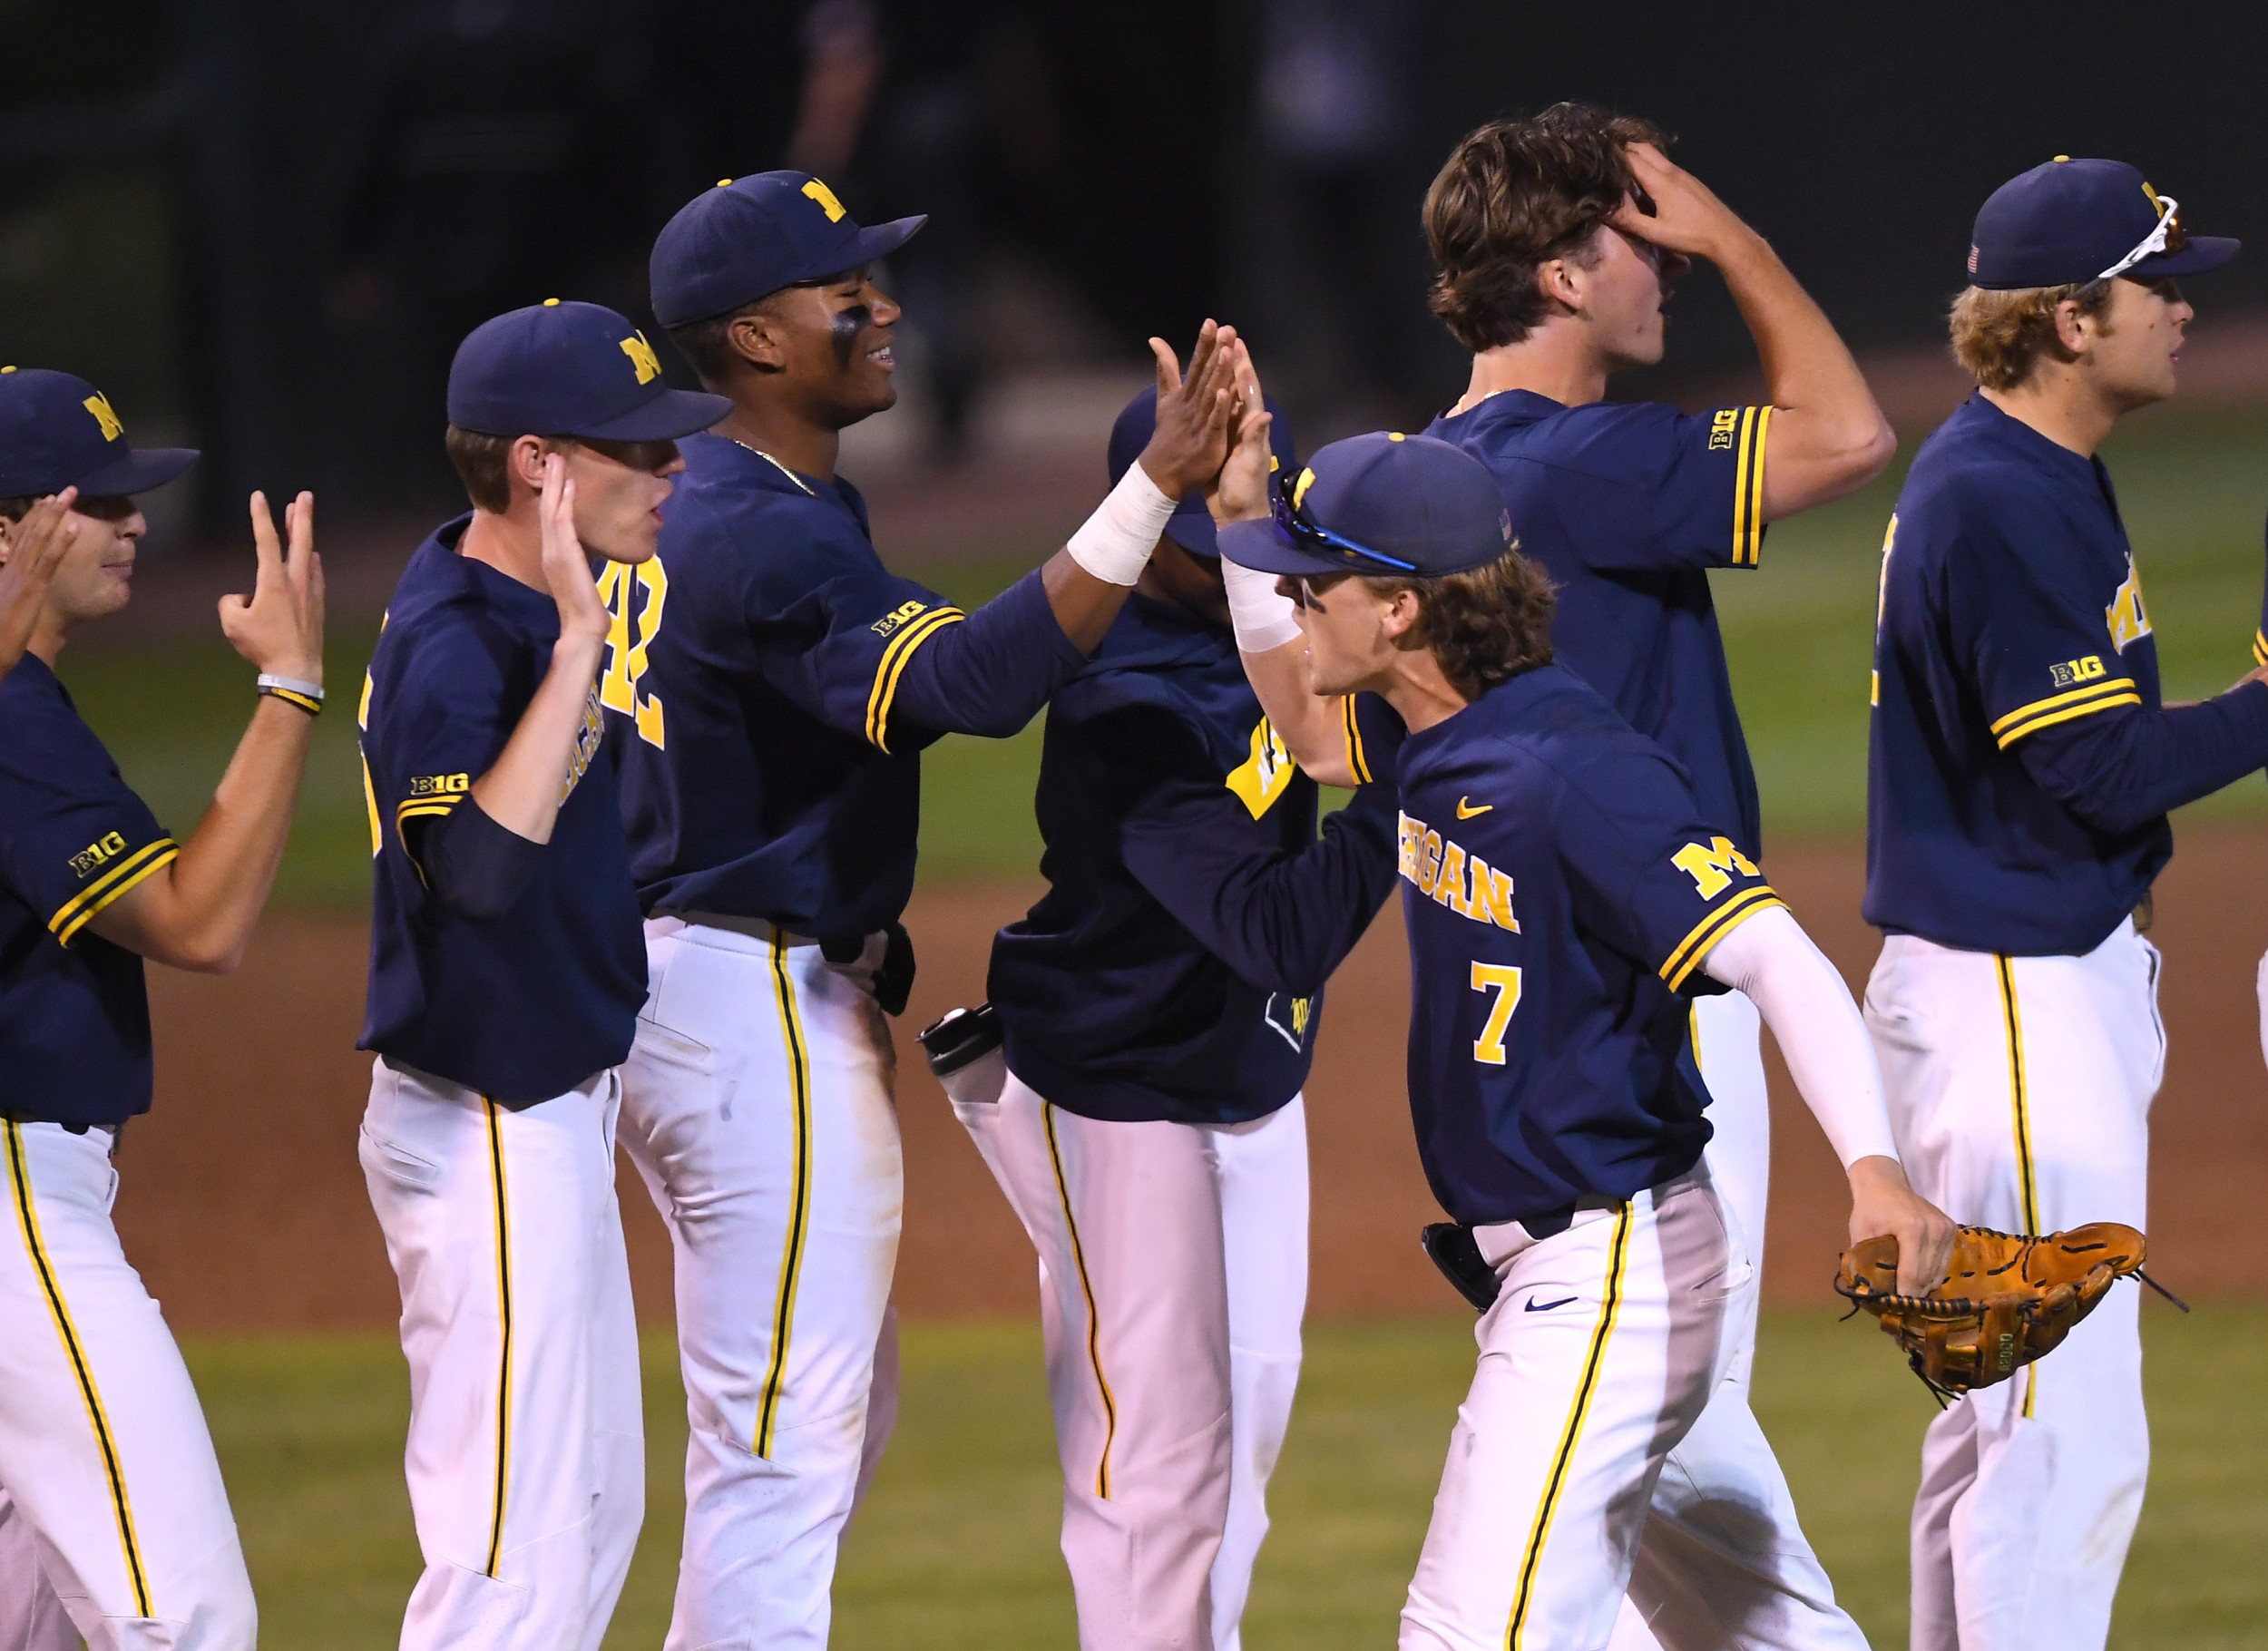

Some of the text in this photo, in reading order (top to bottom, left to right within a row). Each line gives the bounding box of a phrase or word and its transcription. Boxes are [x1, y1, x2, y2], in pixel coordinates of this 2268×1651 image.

[594, 553, 669, 752] 42
[1669, 835, 1762, 902] M
[1470, 960, 1522, 1066] 7
